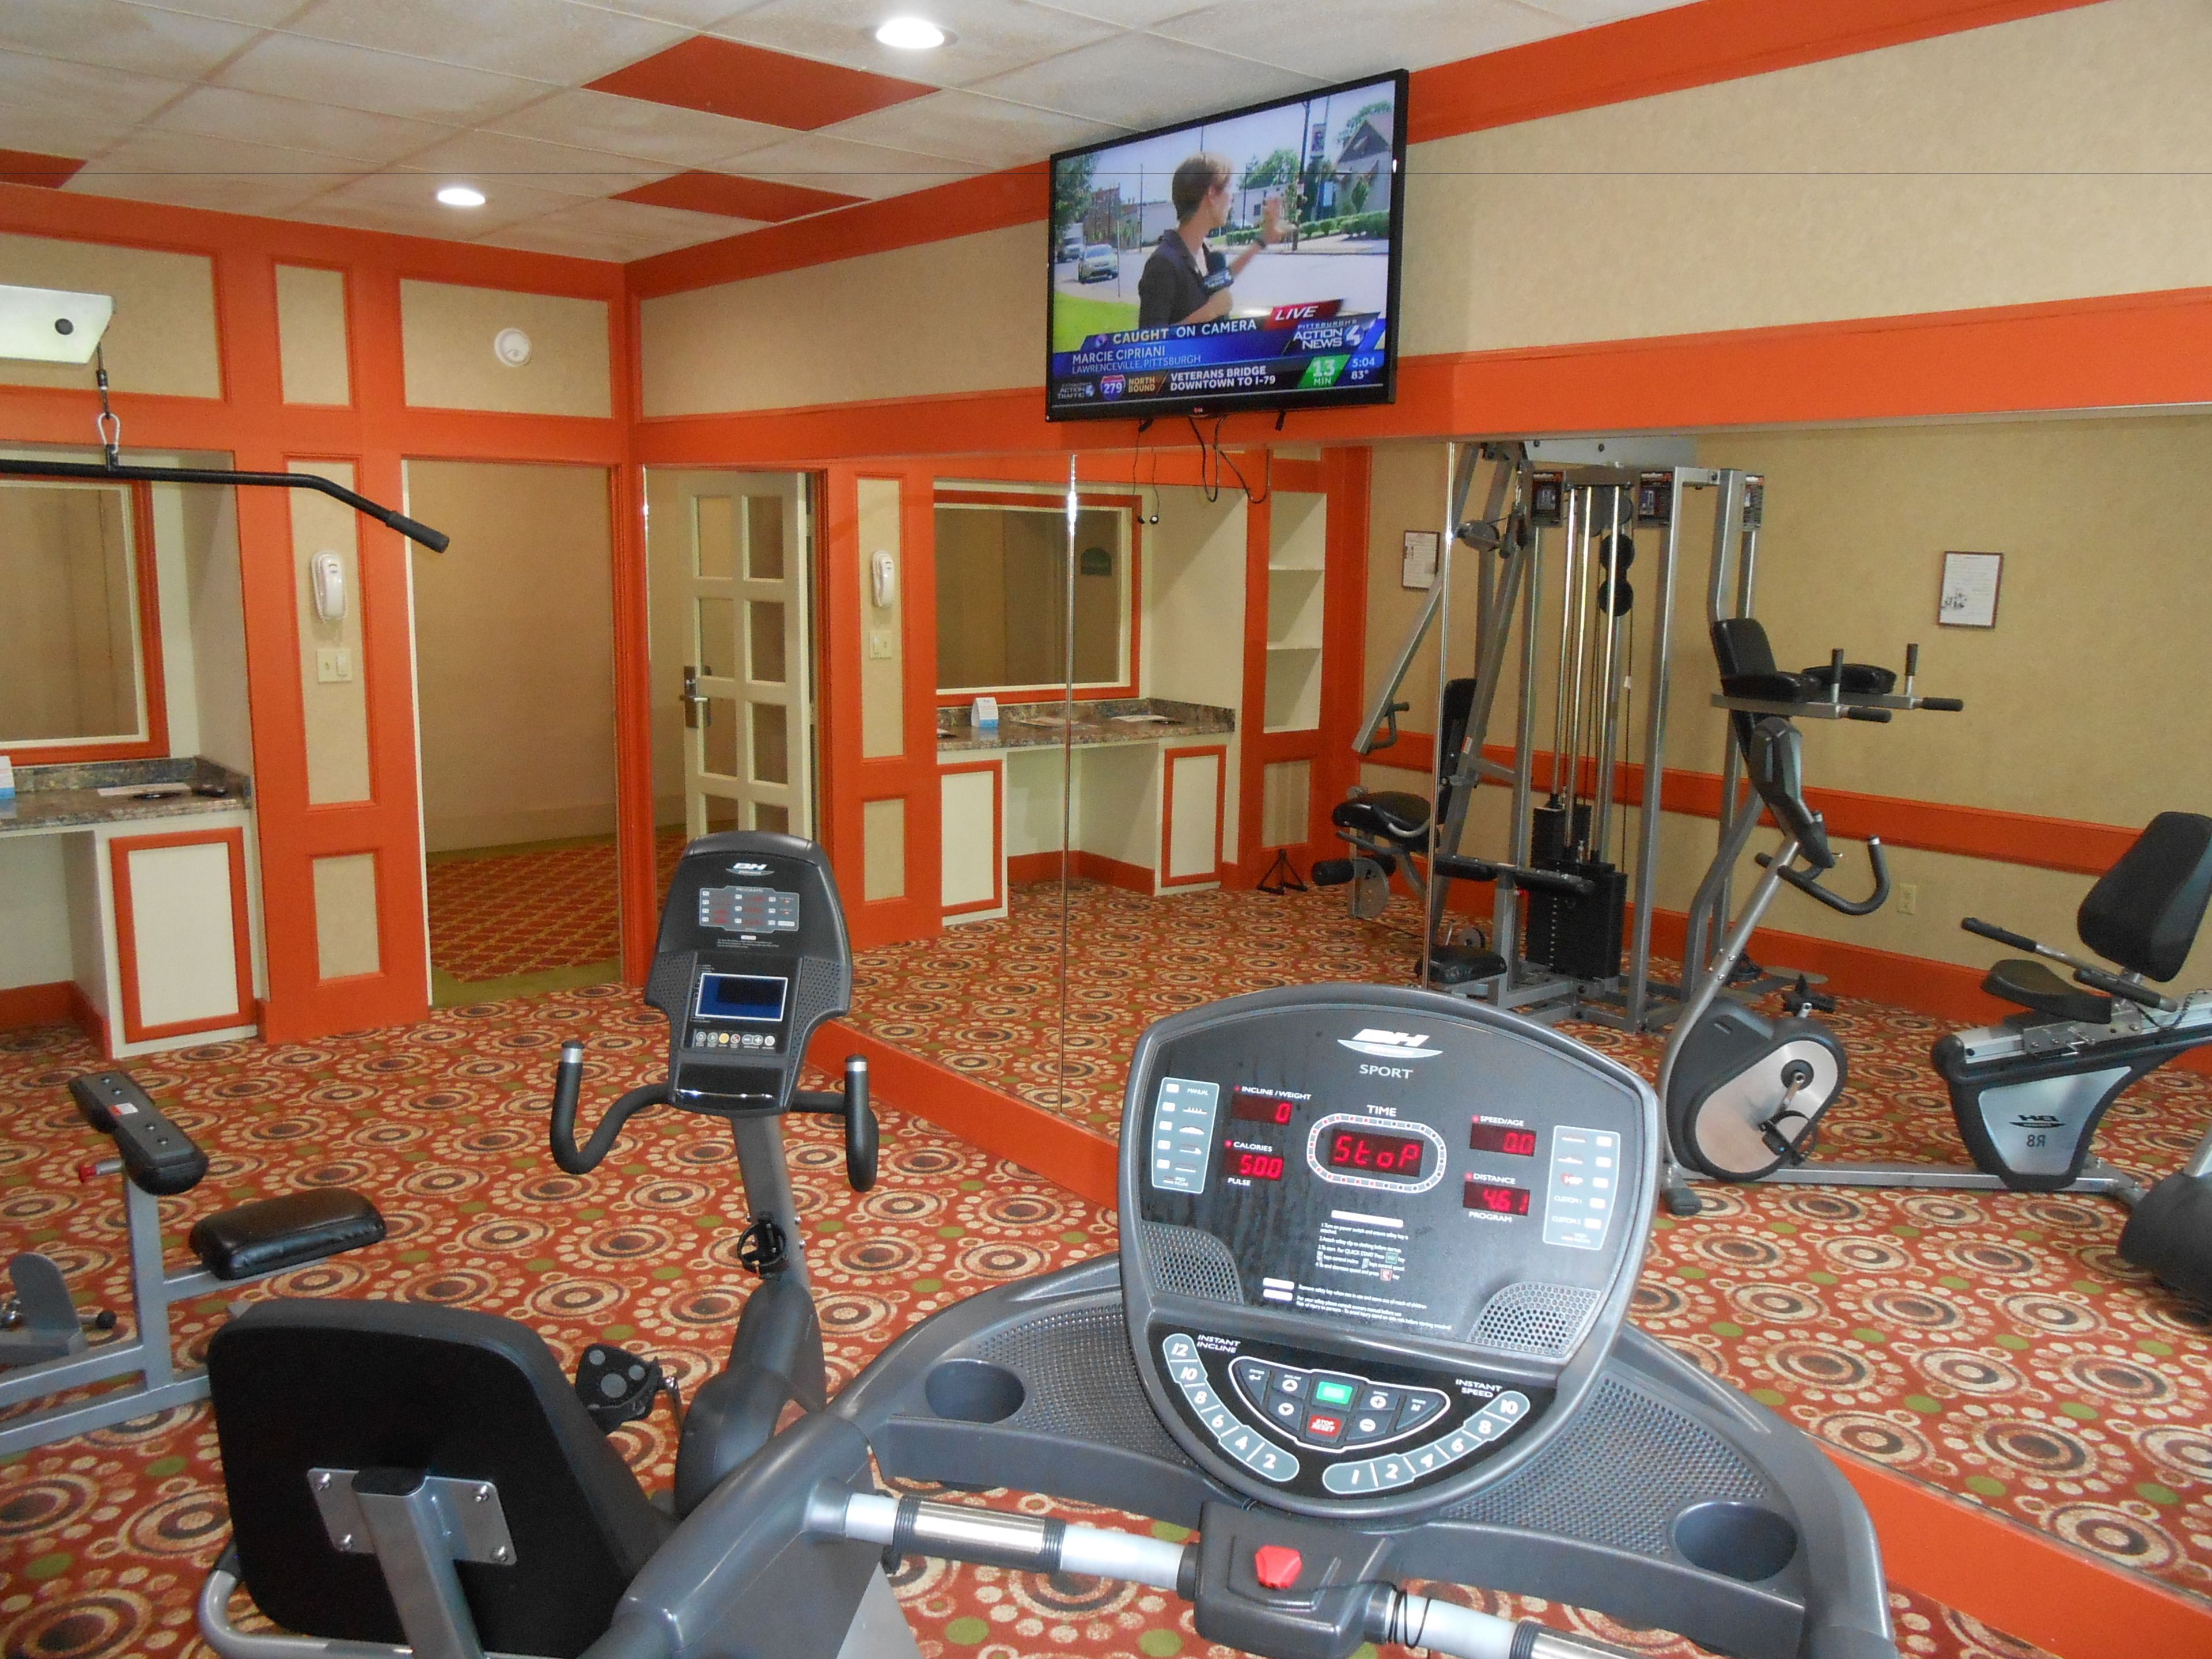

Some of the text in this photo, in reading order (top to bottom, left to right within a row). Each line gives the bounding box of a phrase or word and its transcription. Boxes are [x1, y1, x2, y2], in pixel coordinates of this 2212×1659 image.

[1275, 305, 1319, 321] LIVE
[1113, 320, 1257, 344] CAUGHT ON CAMERA
[1293, 327, 1343, 341] ACTION
[1302, 324, 1361, 350] NEWS 4
[1072, 345, 1165, 364] MARCIE CIPRIANI
[1144, 355, 1201, 368] PITTSBURGH
[1312, 359, 1336, 377] 13
[1353, 357, 1375, 368] 5:04
[1171, 365, 1266, 382] VETERANS BRIDGE
[1103, 382, 1123, 394] 279
[1128, 377, 1156, 385] NORTH
[1171, 375, 1276, 391] DOWNTOWN TO I-79
[1313, 377, 1332, 386] MIN
[1128, 384, 1156, 393] BOUND
[1359, 1064, 1414, 1080] SPORT
[1241, 1086, 1274, 1096] INCLINE
[1366, 1104, 1397, 1117] TIME
[1480, 1115, 1525, 1127] SPEED/AGE
[1233, 1141, 1272, 1152] CALORIES
[1240, 1154, 1284, 1180] 500
[1228, 1177, 1251, 1186] PULSE
[1473, 1173, 1516, 1184] DISTANCE
[1469, 1211, 1513, 1222] PROGRAM
[1196, 1341, 1237, 1354] INCLINE
[1198, 1334, 1241, 1347] INSTANT
[1171, 1343, 1189, 1357] 12
[1180, 1367, 1198, 1381] 10
[1455, 1378, 1503, 1392] INSTANT
[1194, 1391, 1207, 1404] 8
[1461, 1387, 1494, 1398] SPEED
[1499, 1399, 1519, 1415] 10
[1211, 1414, 1224, 1427] 6
[1315, 1418, 1335, 1427] STOP
[1478, 1419, 1492, 1434] 8
[1312, 1423, 1336, 1434] RESET
[1234, 1435, 1248, 1450] 4
[1451, 1438, 1464, 1452] 6
[1262, 1453, 1277, 1469] 2
[1420, 1453, 1434, 1468] 4
[1351, 1469, 1359, 1484] 1
[1385, 1463, 1399, 1479] 2
